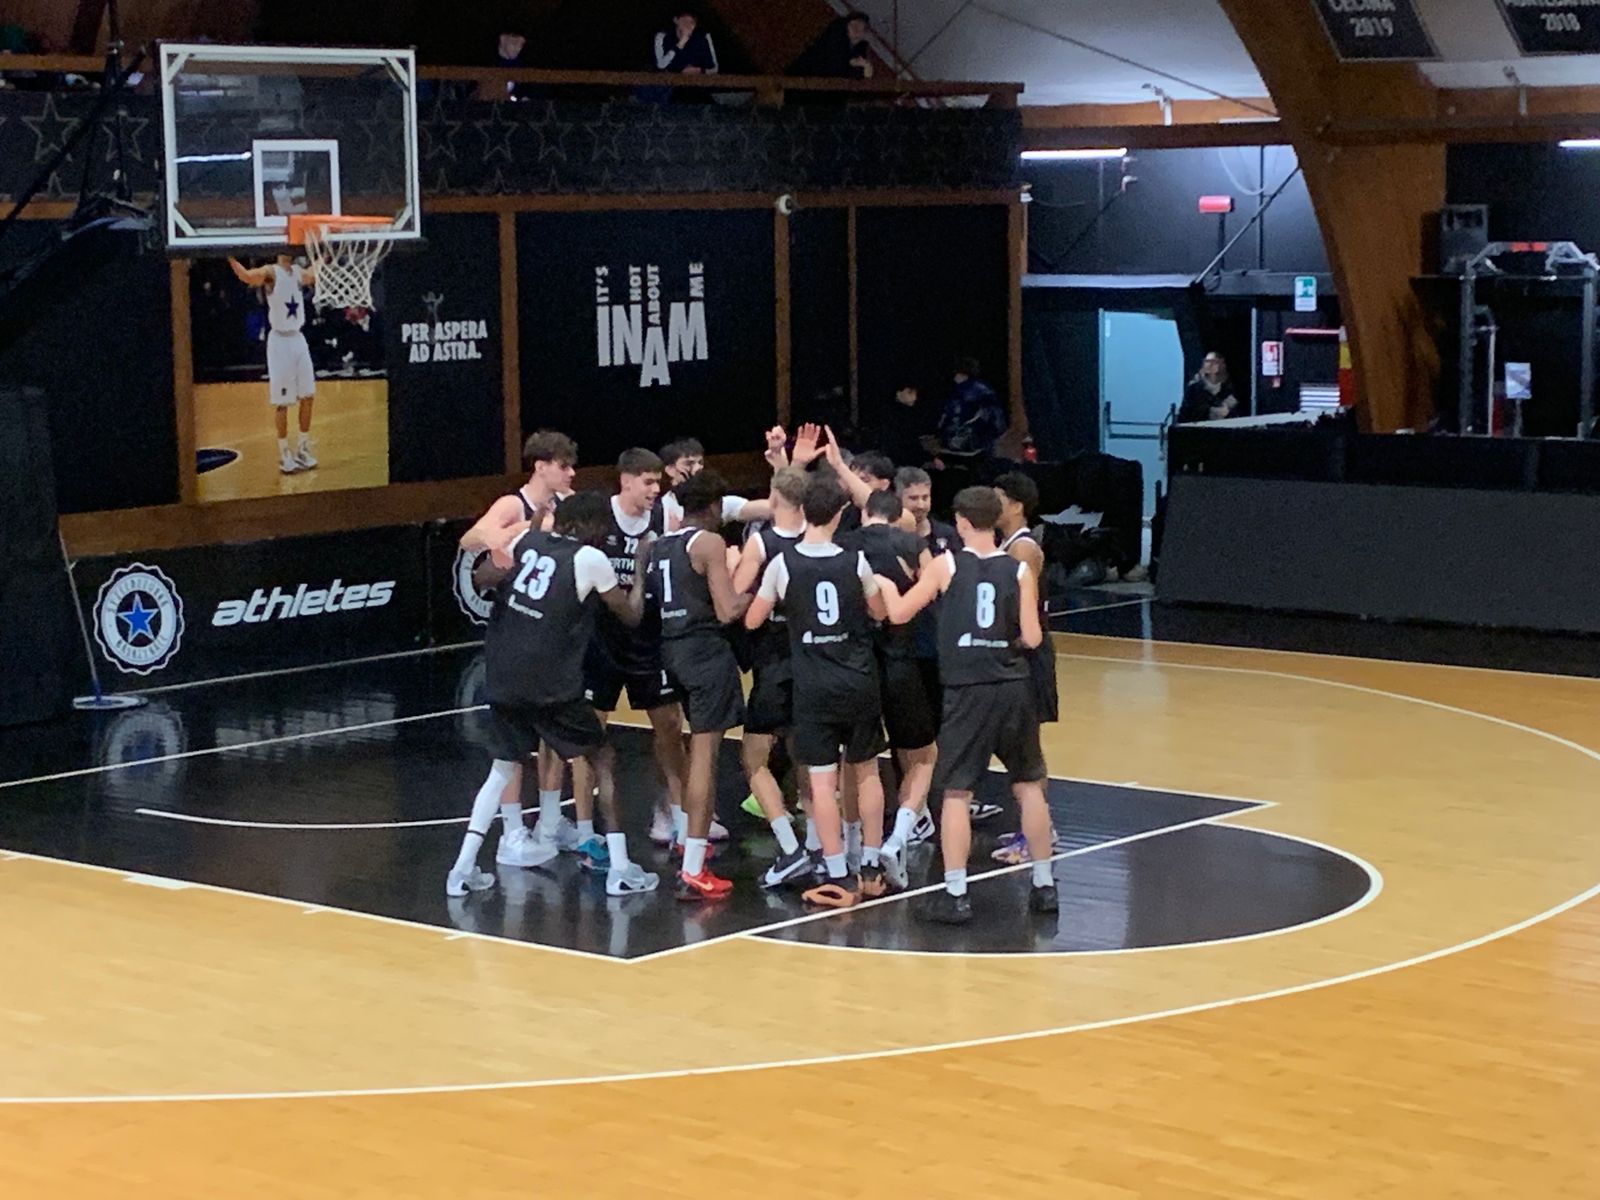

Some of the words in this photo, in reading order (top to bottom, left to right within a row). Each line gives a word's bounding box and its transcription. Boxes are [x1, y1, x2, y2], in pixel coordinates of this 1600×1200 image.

[1349, 17, 1394, 37] 2019
[595, 265, 609, 303] IT'S
[629, 264, 642, 301] NOT
[646, 264, 661, 326] ABOUT
[688, 262, 704, 298] ME
[401, 323, 430, 344] PER
[434, 319, 488, 341] ASPERA
[409, 343, 430, 363] AD
[432, 340, 482, 362] ASTRA.
[513, 548, 557, 600] 23
[659, 558, 672, 602] 1
[211, 578, 396, 627] athletes
[815, 580, 840, 626] 9
[976, 581, 996, 629] 8
